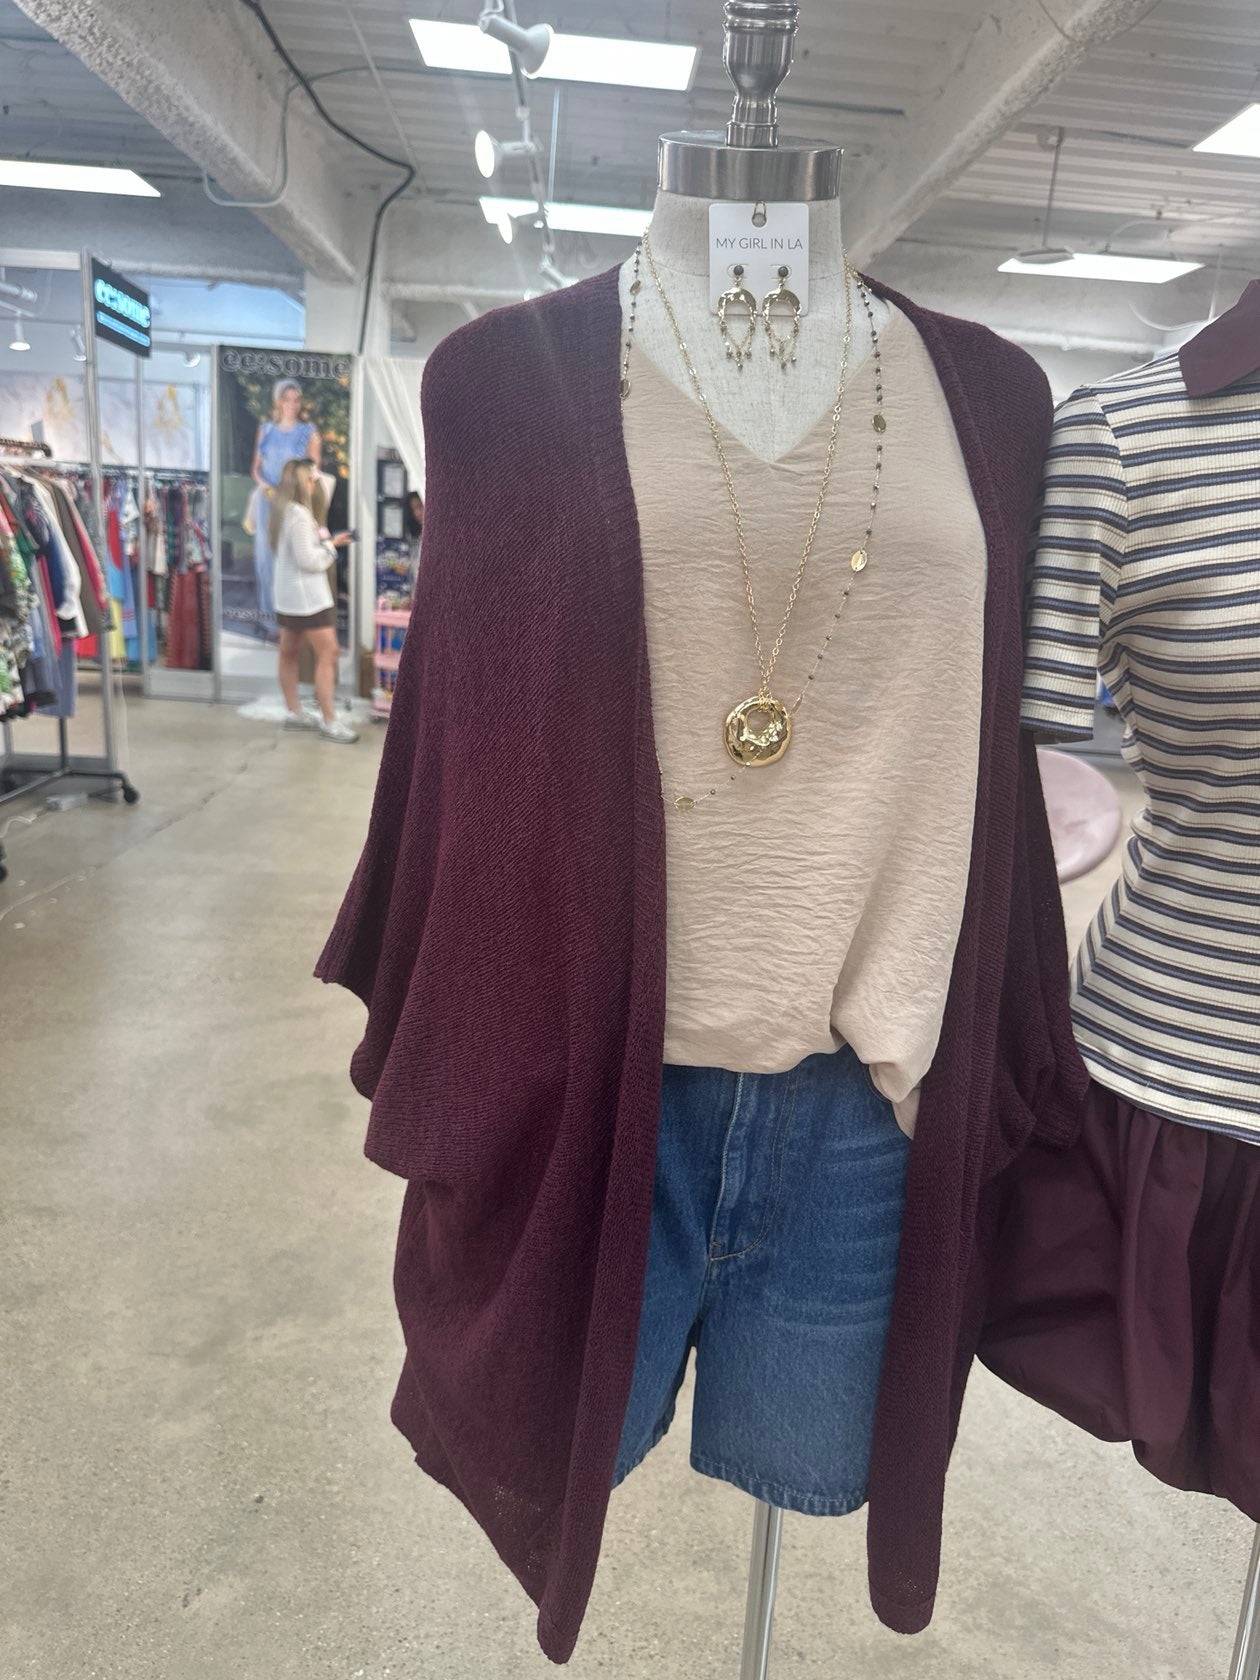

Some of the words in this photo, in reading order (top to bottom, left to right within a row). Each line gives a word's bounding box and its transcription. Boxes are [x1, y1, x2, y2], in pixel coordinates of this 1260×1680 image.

[716, 238, 736, 249] MY
[738, 237, 767, 250] GIRL
[770, 238, 784, 249] IN
[787, 238, 803, 250] LA
